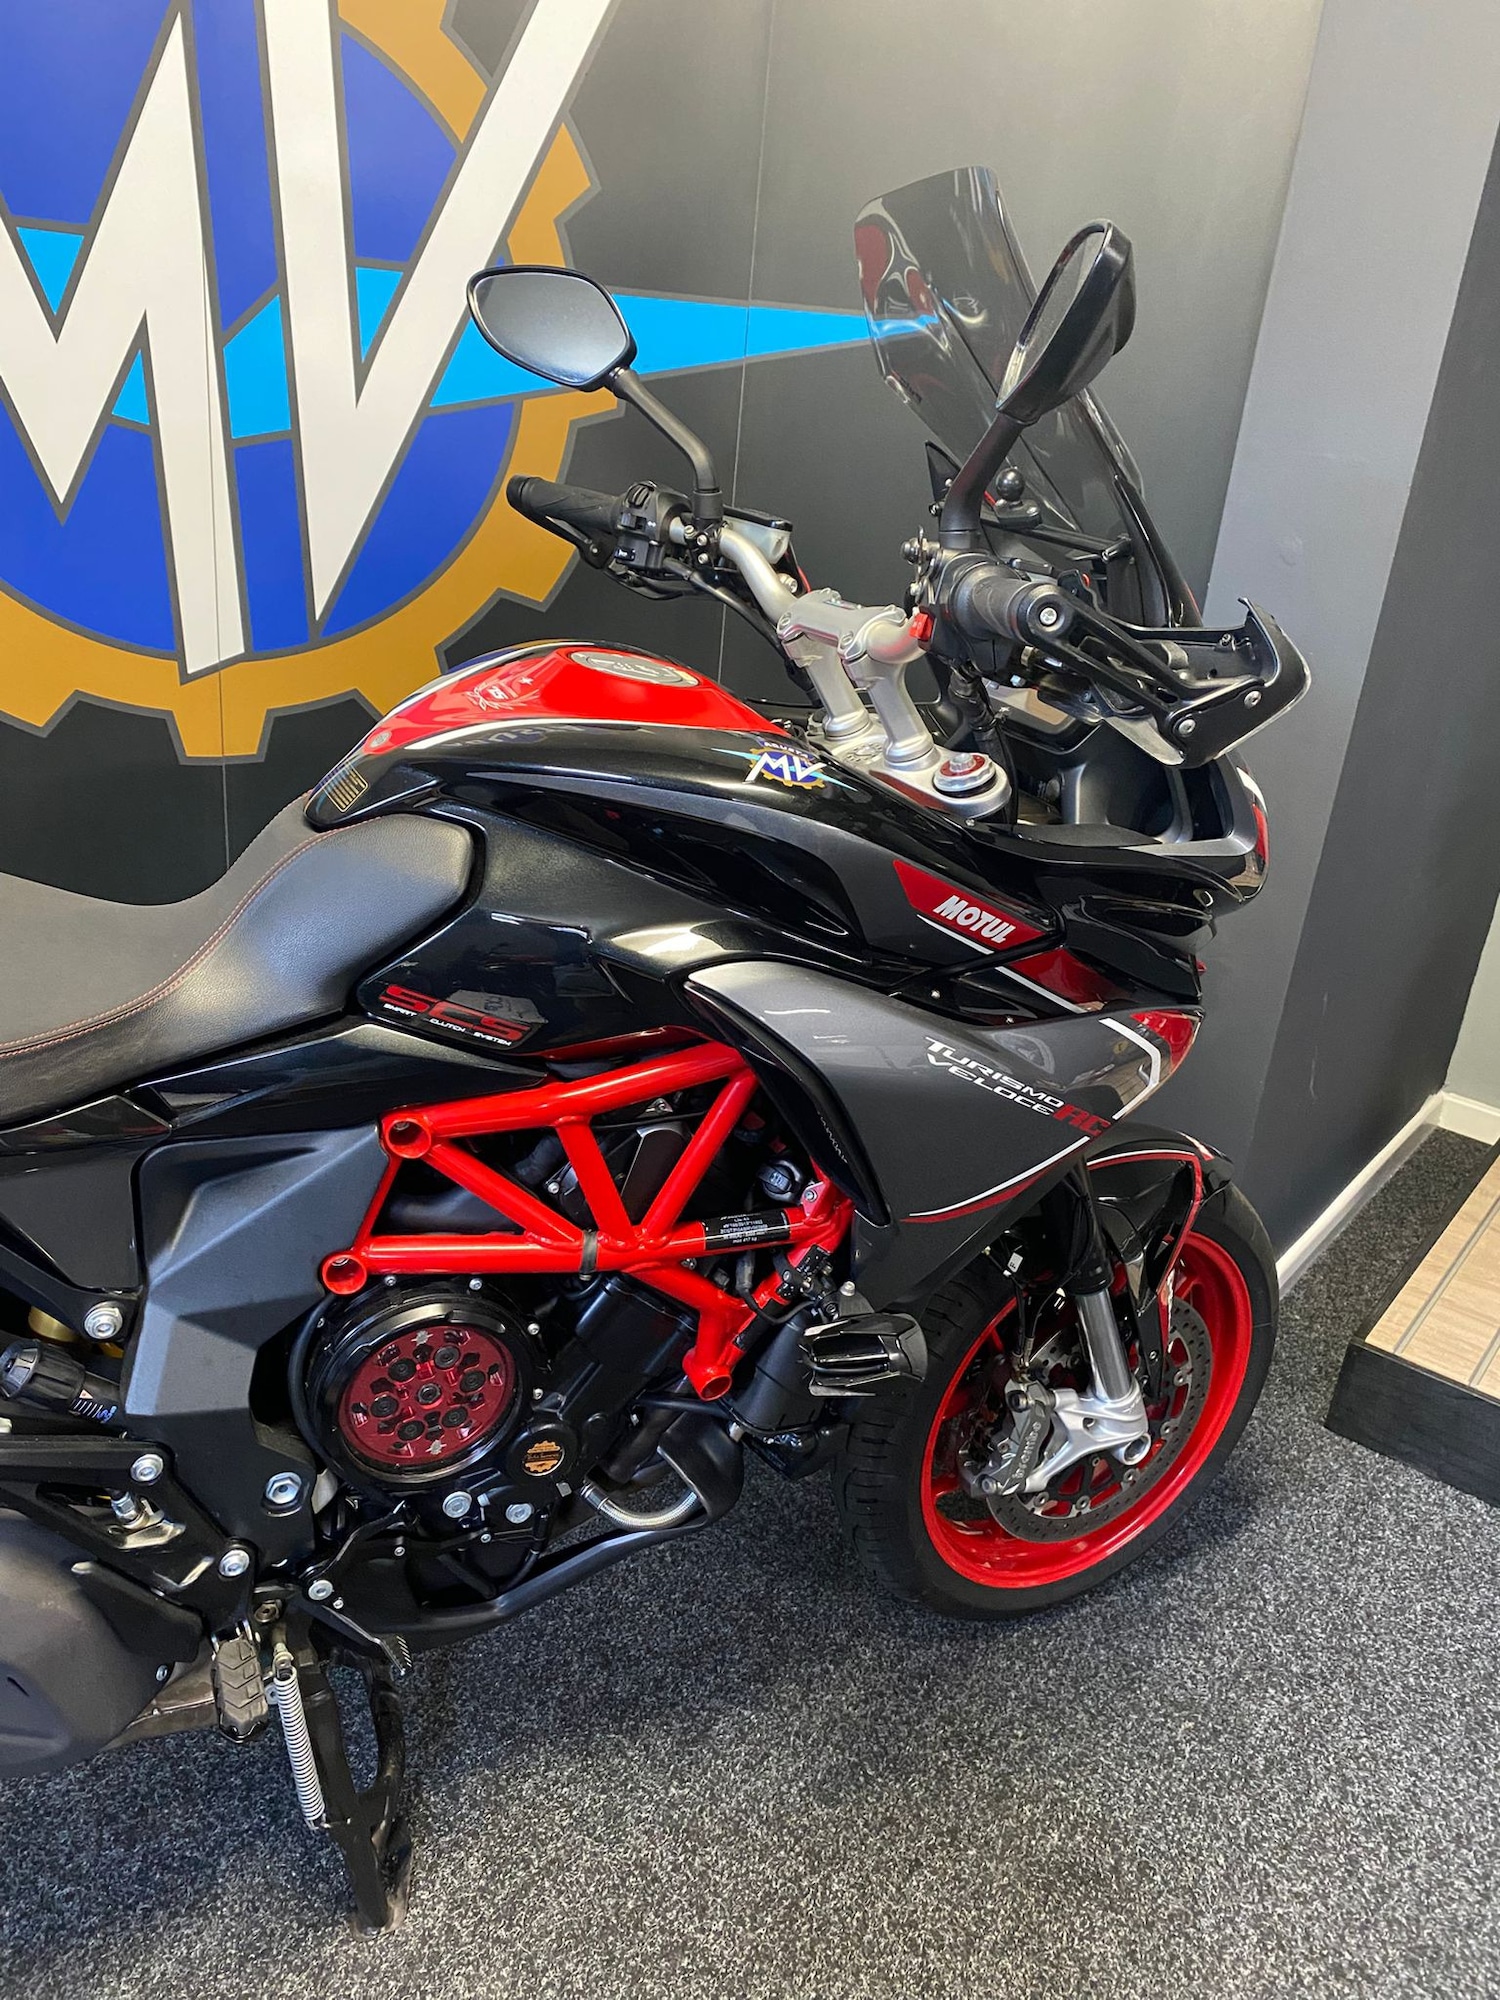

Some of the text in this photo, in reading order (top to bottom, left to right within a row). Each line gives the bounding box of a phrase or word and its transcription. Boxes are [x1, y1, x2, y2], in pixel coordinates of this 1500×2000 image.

[744, 752, 828, 783] MV
[932, 894, 1017, 944] MOTUL
[378, 984, 531, 1041] SCS
[383, 1003, 512, 1046] SMART CLUTCH SYSTEM
[925, 1036, 1065, 1108] TURISMO
[927, 1053, 1112, 1137] VELOCE RC
[1011, 1421, 1042, 1479] brembo
